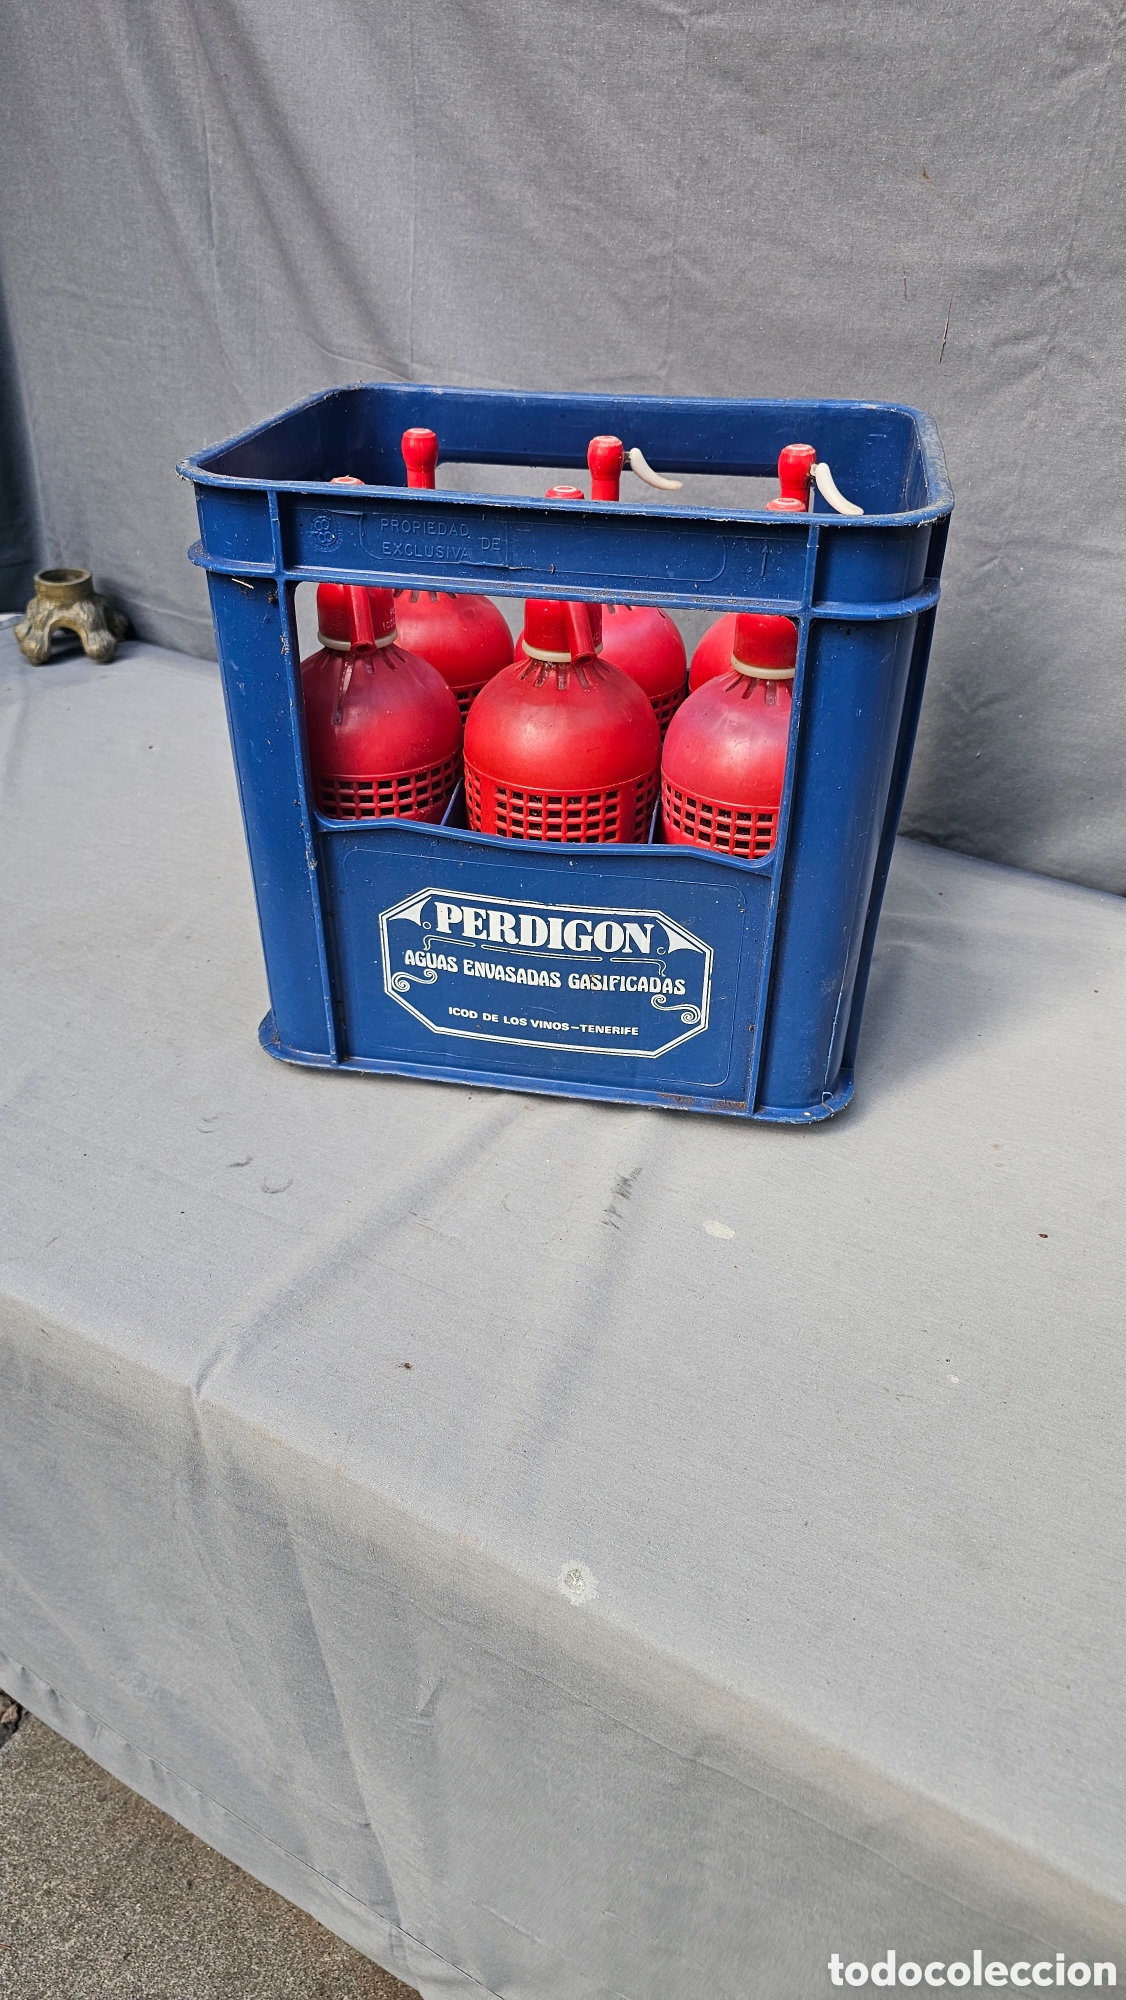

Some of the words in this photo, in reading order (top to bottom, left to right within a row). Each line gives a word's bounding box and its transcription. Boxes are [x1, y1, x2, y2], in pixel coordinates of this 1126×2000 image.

[380, 518, 470, 537] PROPIEDAD
[382, 540, 470, 560] EXCLUSIVA
[481, 536, 501, 551] DE
[434, 902, 655, 954] PERDIGON
[404, 950, 459, 973] AGUAS
[463, 960, 562, 989] ENVASADAS
[568, 973, 687, 996] GASIFICADAS
[448, 1006, 479, 1020] ICOD
[482, 1013, 500, 1024] DE
[503, 1015, 528, 1027] LOS
